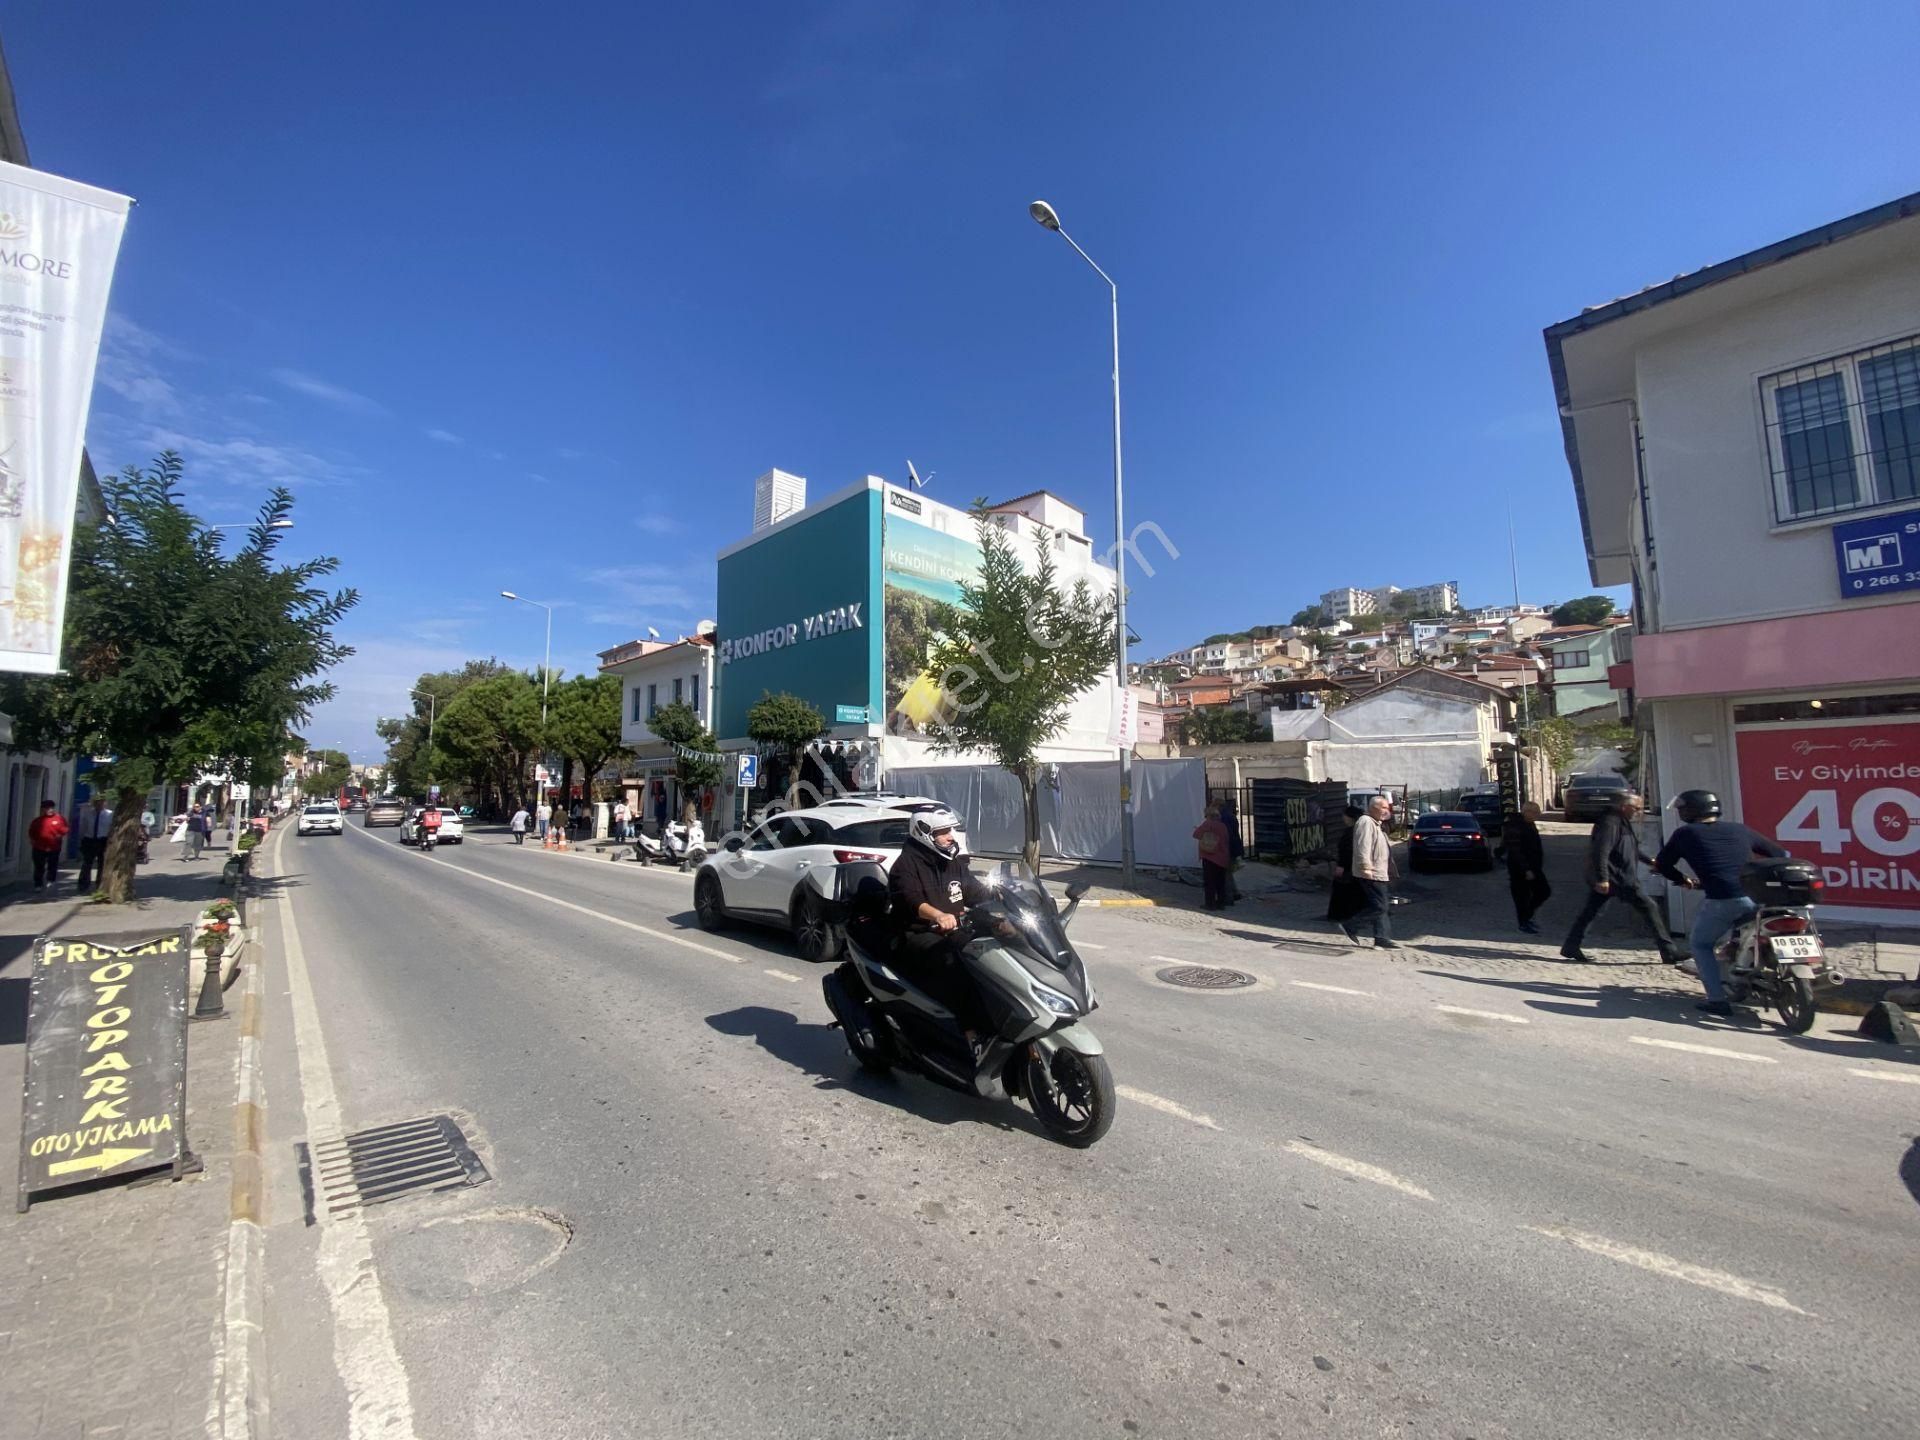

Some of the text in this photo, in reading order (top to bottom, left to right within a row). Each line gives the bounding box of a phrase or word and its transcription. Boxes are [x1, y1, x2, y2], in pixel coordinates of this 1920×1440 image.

[1853, 579, 1864, 589] 0
[1869, 574, 1900, 587] 266
[734, 602, 863, 660] KONFOR YATAK
[1120, 690, 1130, 736] OTOPARK
[741, 757, 751, 772] P
[1774, 762, 1920, 782] Ev Giyimde
[1287, 798, 1307, 825] OTO
[1774, 938, 1787, 947] 10
[1793, 947, 1809, 956] 09
[79, 961, 134, 1125] OTOPARK
[31, 1132, 71, 1157] OTO
